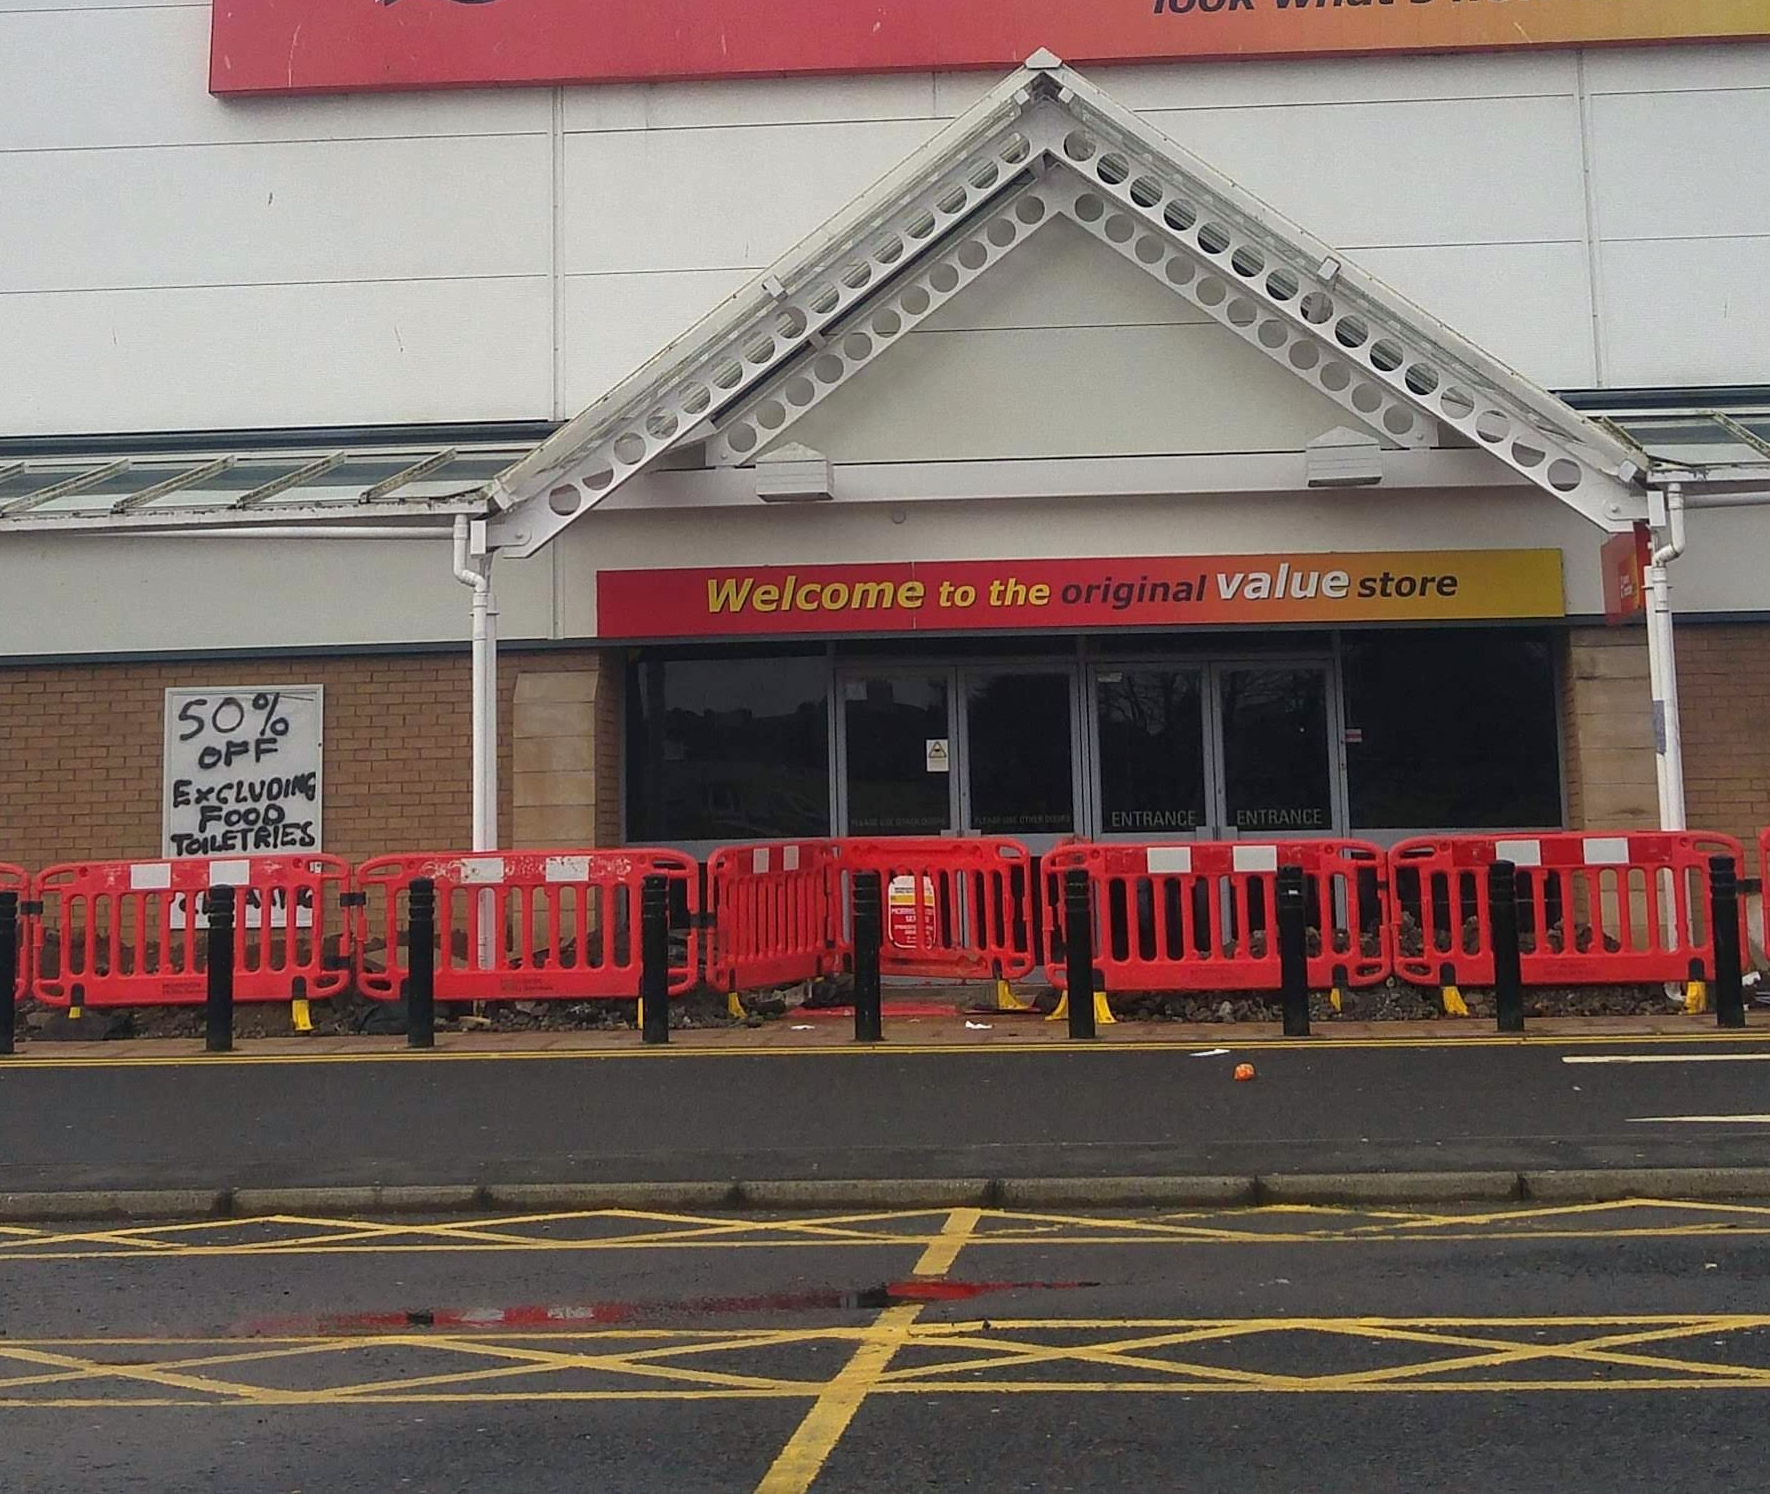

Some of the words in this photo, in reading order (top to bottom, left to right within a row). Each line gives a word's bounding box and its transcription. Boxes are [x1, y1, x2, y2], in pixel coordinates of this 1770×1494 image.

[706, 576, 925, 614] Welcome
[938, 581, 976, 608] to
[988, 578, 1050, 608] the
[1060, 574, 1208, 611] original
[1215, 561, 1351, 602] value
[1356, 569, 1458, 599] store
[178, 692, 290, 742] 50%
[198, 736, 280, 770] OFF
[198, 803, 286, 834] FOOD
[1111, 809, 1197, 827] ENTRANCE
[1236, 807, 1323, 826] ENTRANCE
[171, 820, 316, 857] TOILETRIES
